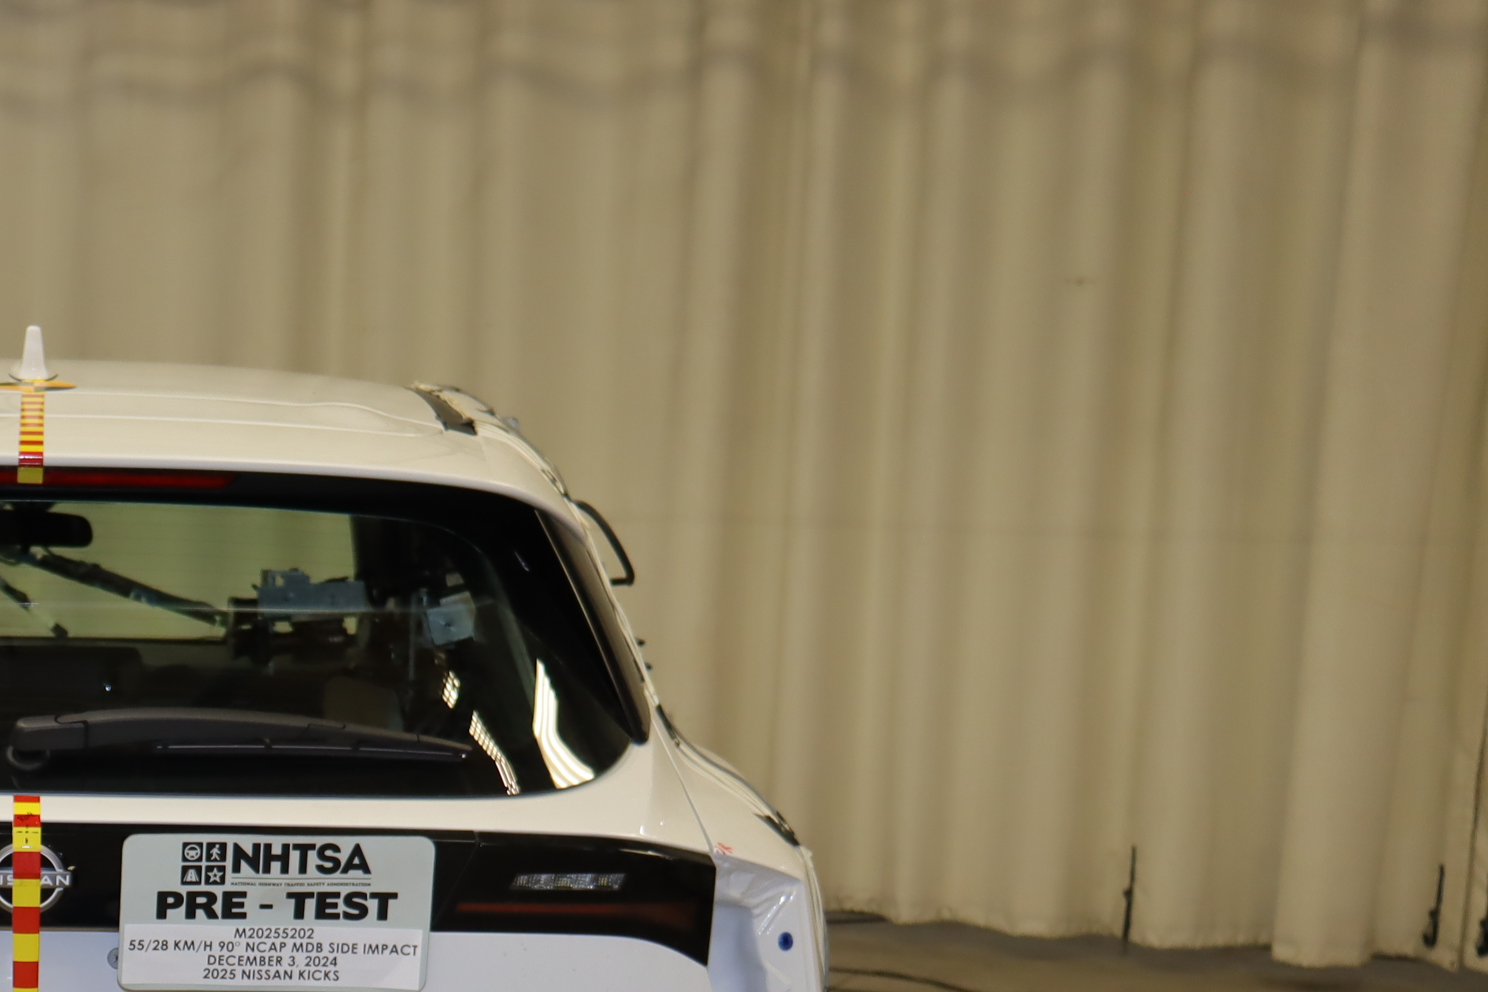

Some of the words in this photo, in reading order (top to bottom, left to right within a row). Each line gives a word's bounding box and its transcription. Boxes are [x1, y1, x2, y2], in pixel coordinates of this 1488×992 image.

[232, 843, 371, 875] NHTSA
[156, 891, 247, 919] PRE
[286, 891, 398, 921] TEST
[234, 928, 314, 939] M20255202
[129, 940, 168, 952] 55/28
[174, 940, 212, 952] KM/H
[219, 941, 240, 952] 90°
[246, 942, 286, 953] NCAP
[291, 942, 323, 953] MDB
[329, 942, 358, 954] SIDE
[363, 944, 418, 956] IMPACT
[208, 955, 282, 966] DECEMBER
[288, 956, 300, 968] 3,
[305, 956, 337, 967] 2024
[203, 968, 236, 979] 2025
[242, 969, 292, 980] NISSAN
[299, 970, 339, 981] KICKS
